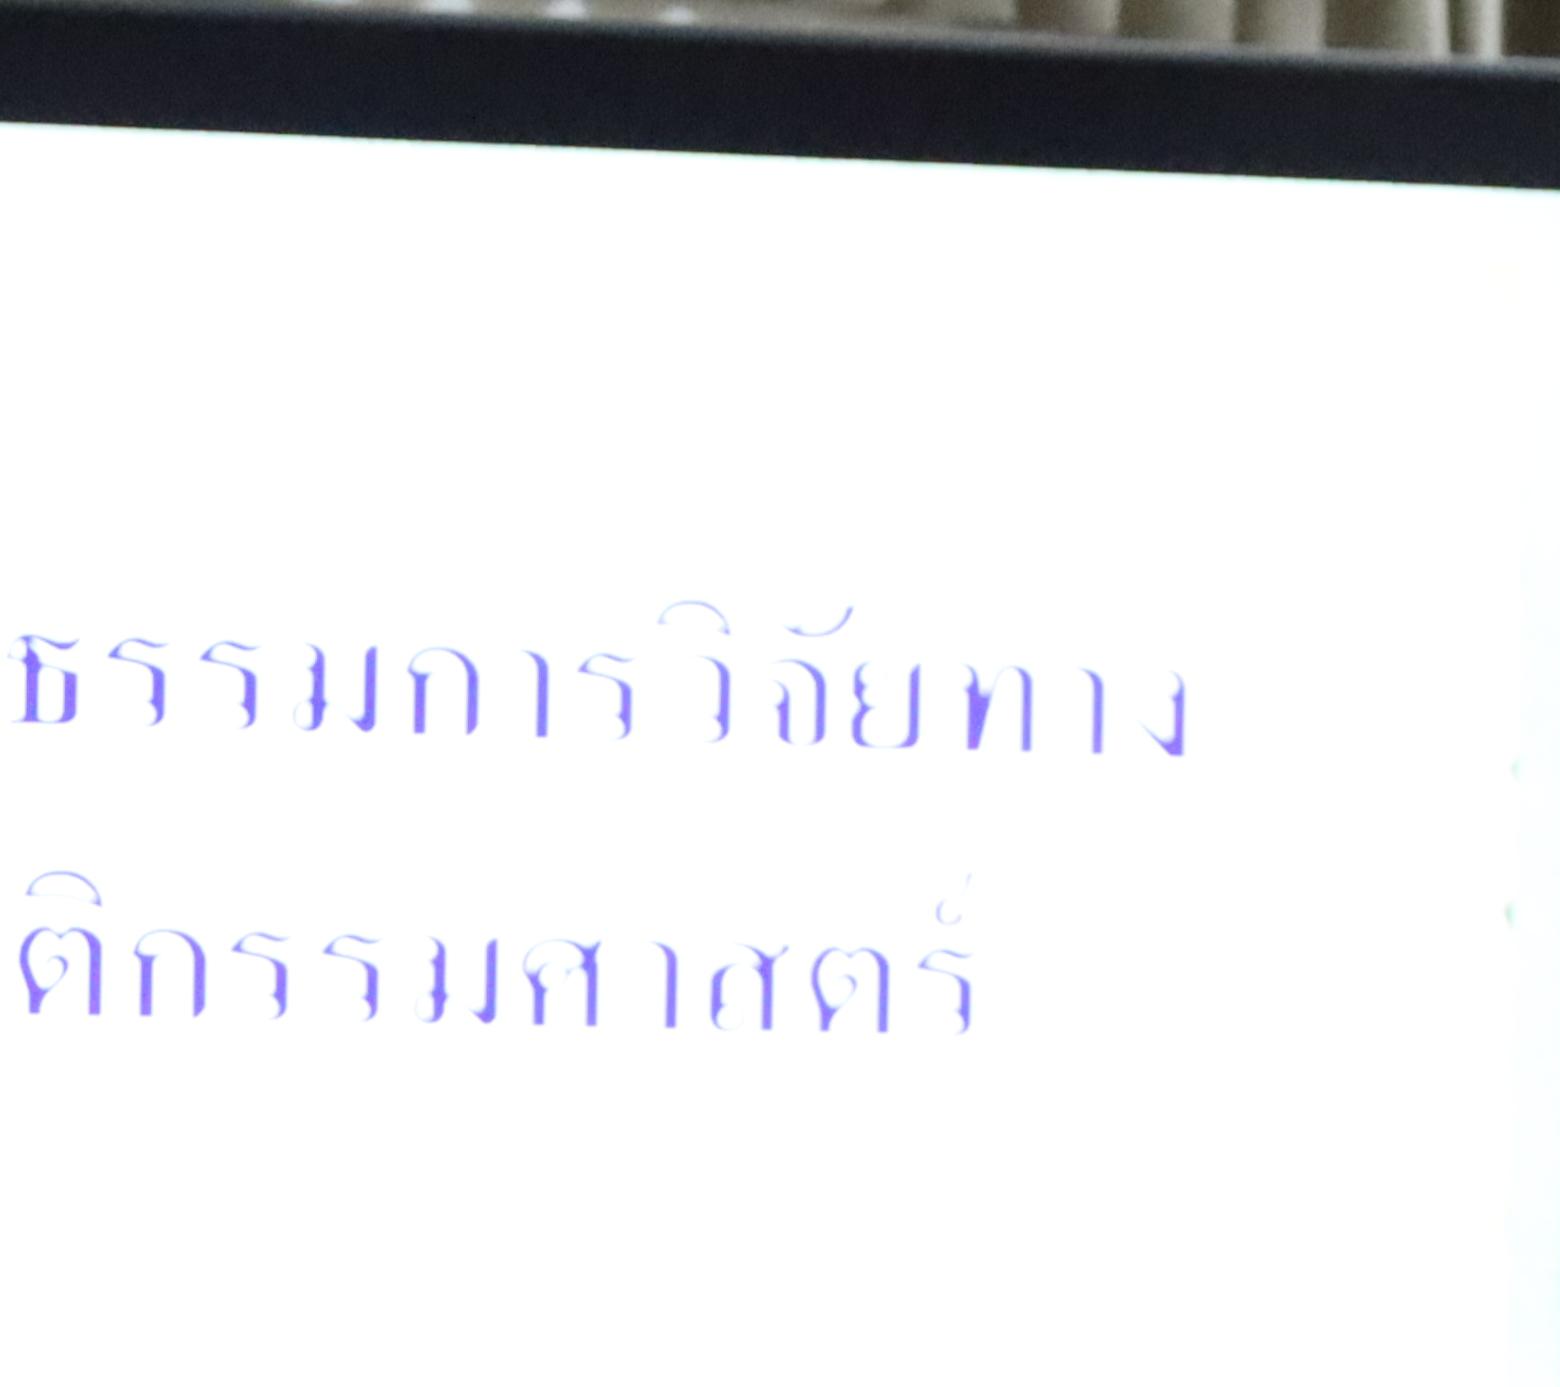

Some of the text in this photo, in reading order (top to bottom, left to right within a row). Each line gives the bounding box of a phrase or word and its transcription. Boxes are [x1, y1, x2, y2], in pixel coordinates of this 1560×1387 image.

[7, 599, 1186, 757] ธรรมการวิจัยทาง
